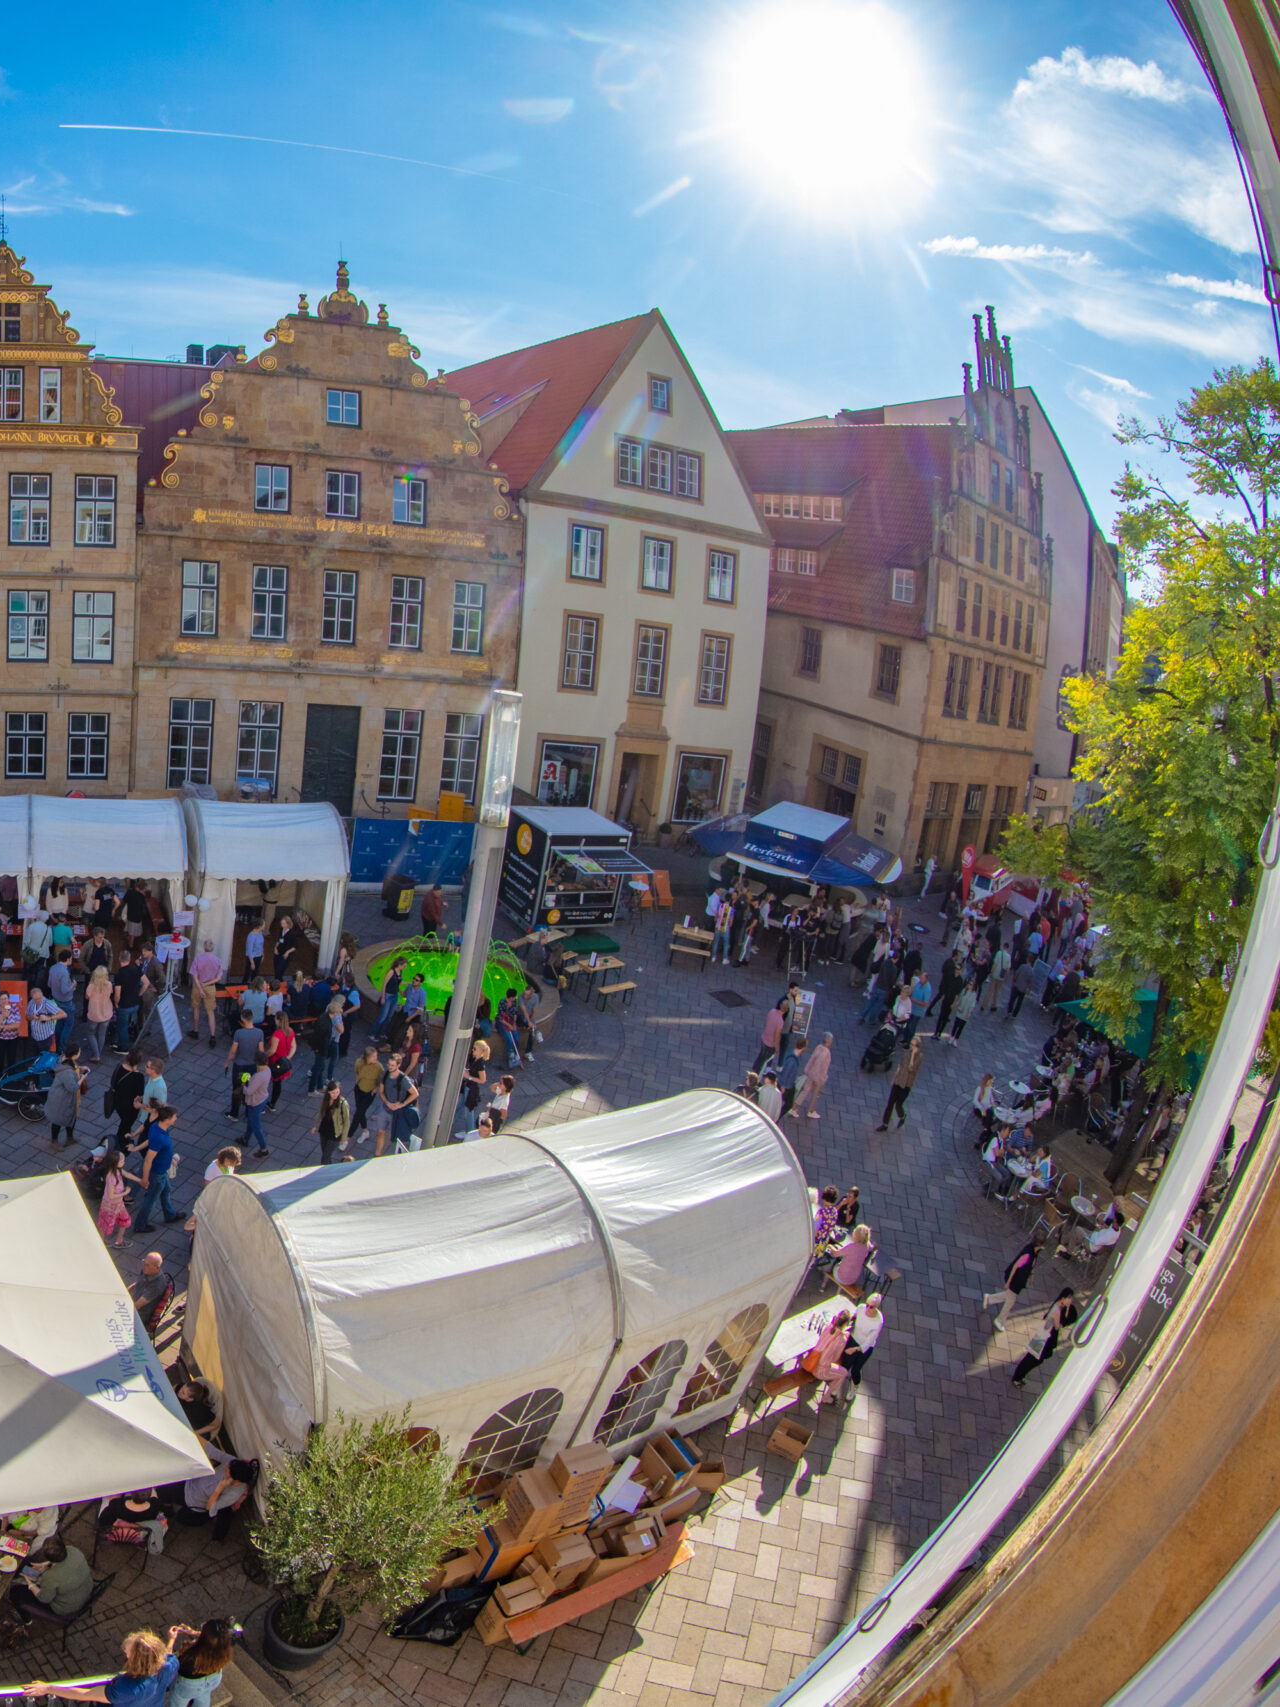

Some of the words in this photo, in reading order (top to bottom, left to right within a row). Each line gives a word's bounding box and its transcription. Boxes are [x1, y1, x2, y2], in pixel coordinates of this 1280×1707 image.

[743, 841, 806, 866] Herforder
[105, 1317, 138, 1378] Wernings
[114, 1299, 149, 1362] Weinstube
